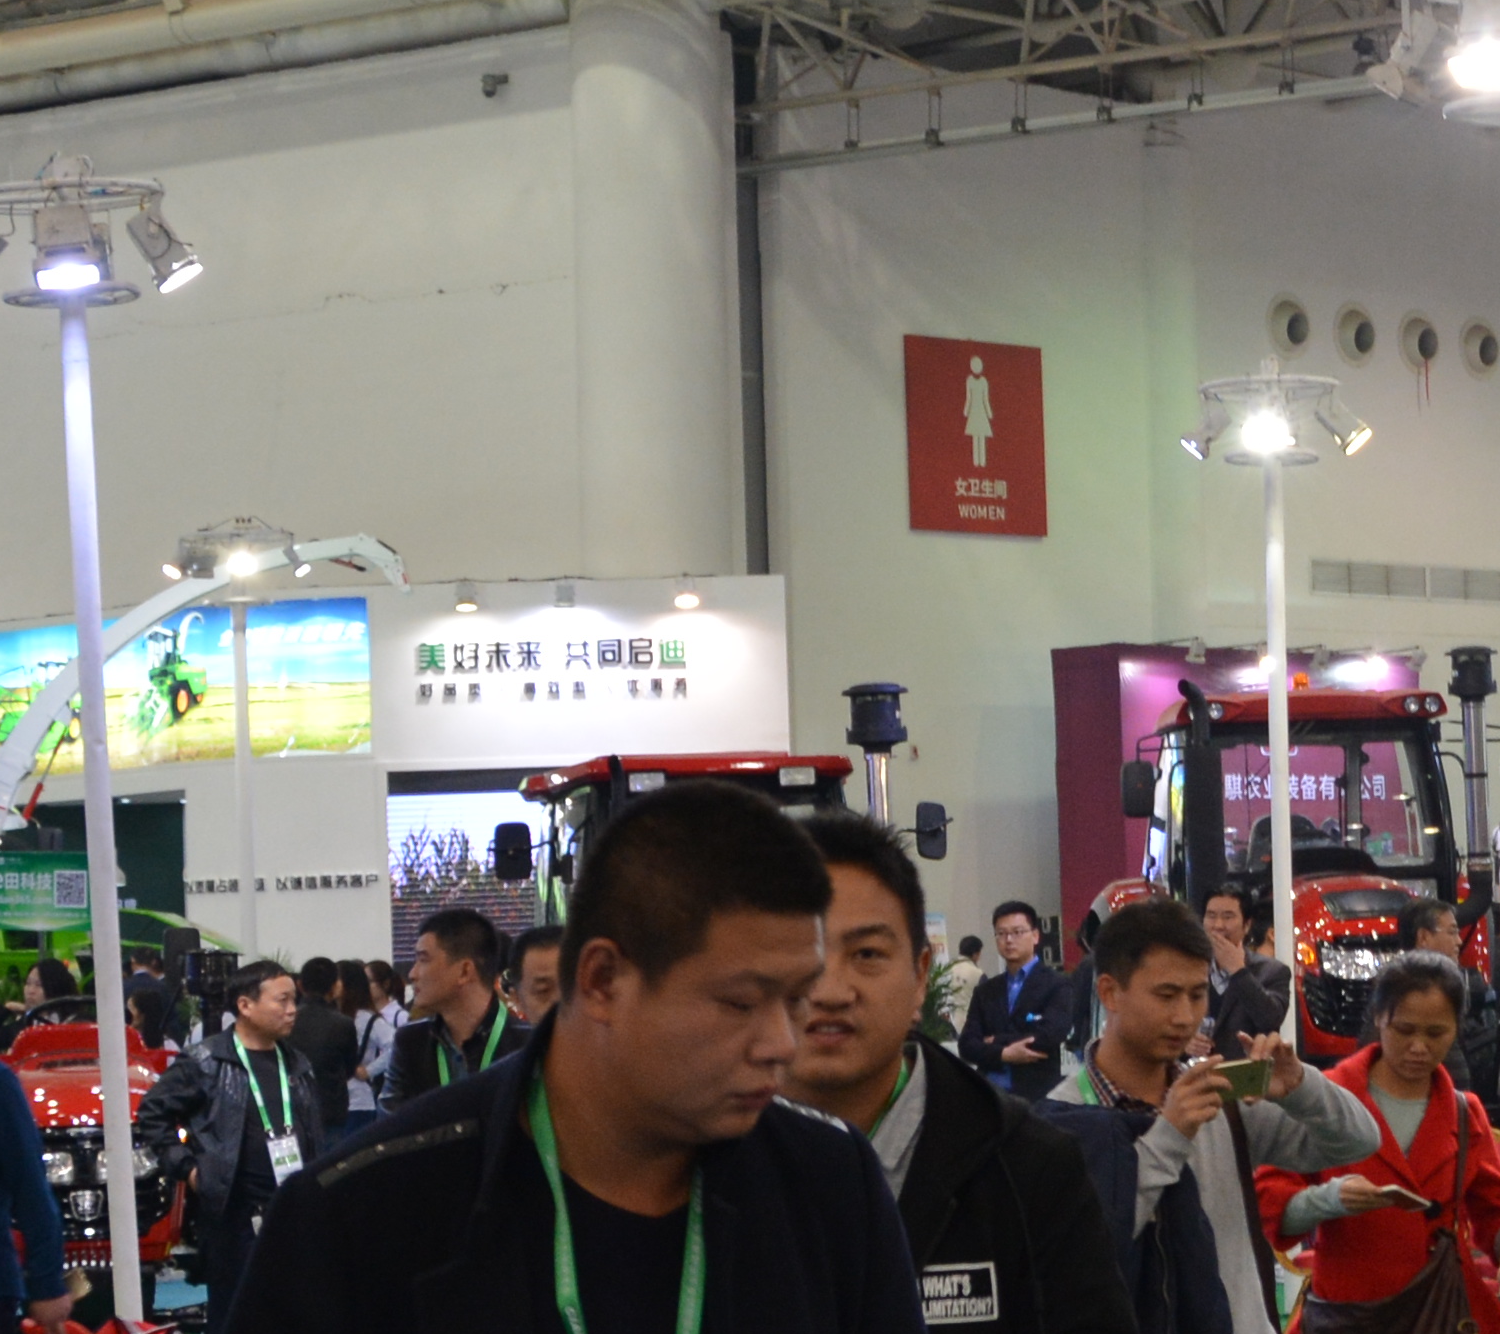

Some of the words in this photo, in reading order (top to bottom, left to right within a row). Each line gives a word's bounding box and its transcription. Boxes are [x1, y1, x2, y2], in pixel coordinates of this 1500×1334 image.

[955, 477, 1007, 499] 女卫生间
[958, 504, 1005, 520] WOMEN
[418, 641, 541, 670] 美好未来
[565, 638, 686, 670] 共同启迪
[922, 1274, 971, 1298] WHAT'S
[922, 1296, 992, 1318] LIMITATION?
